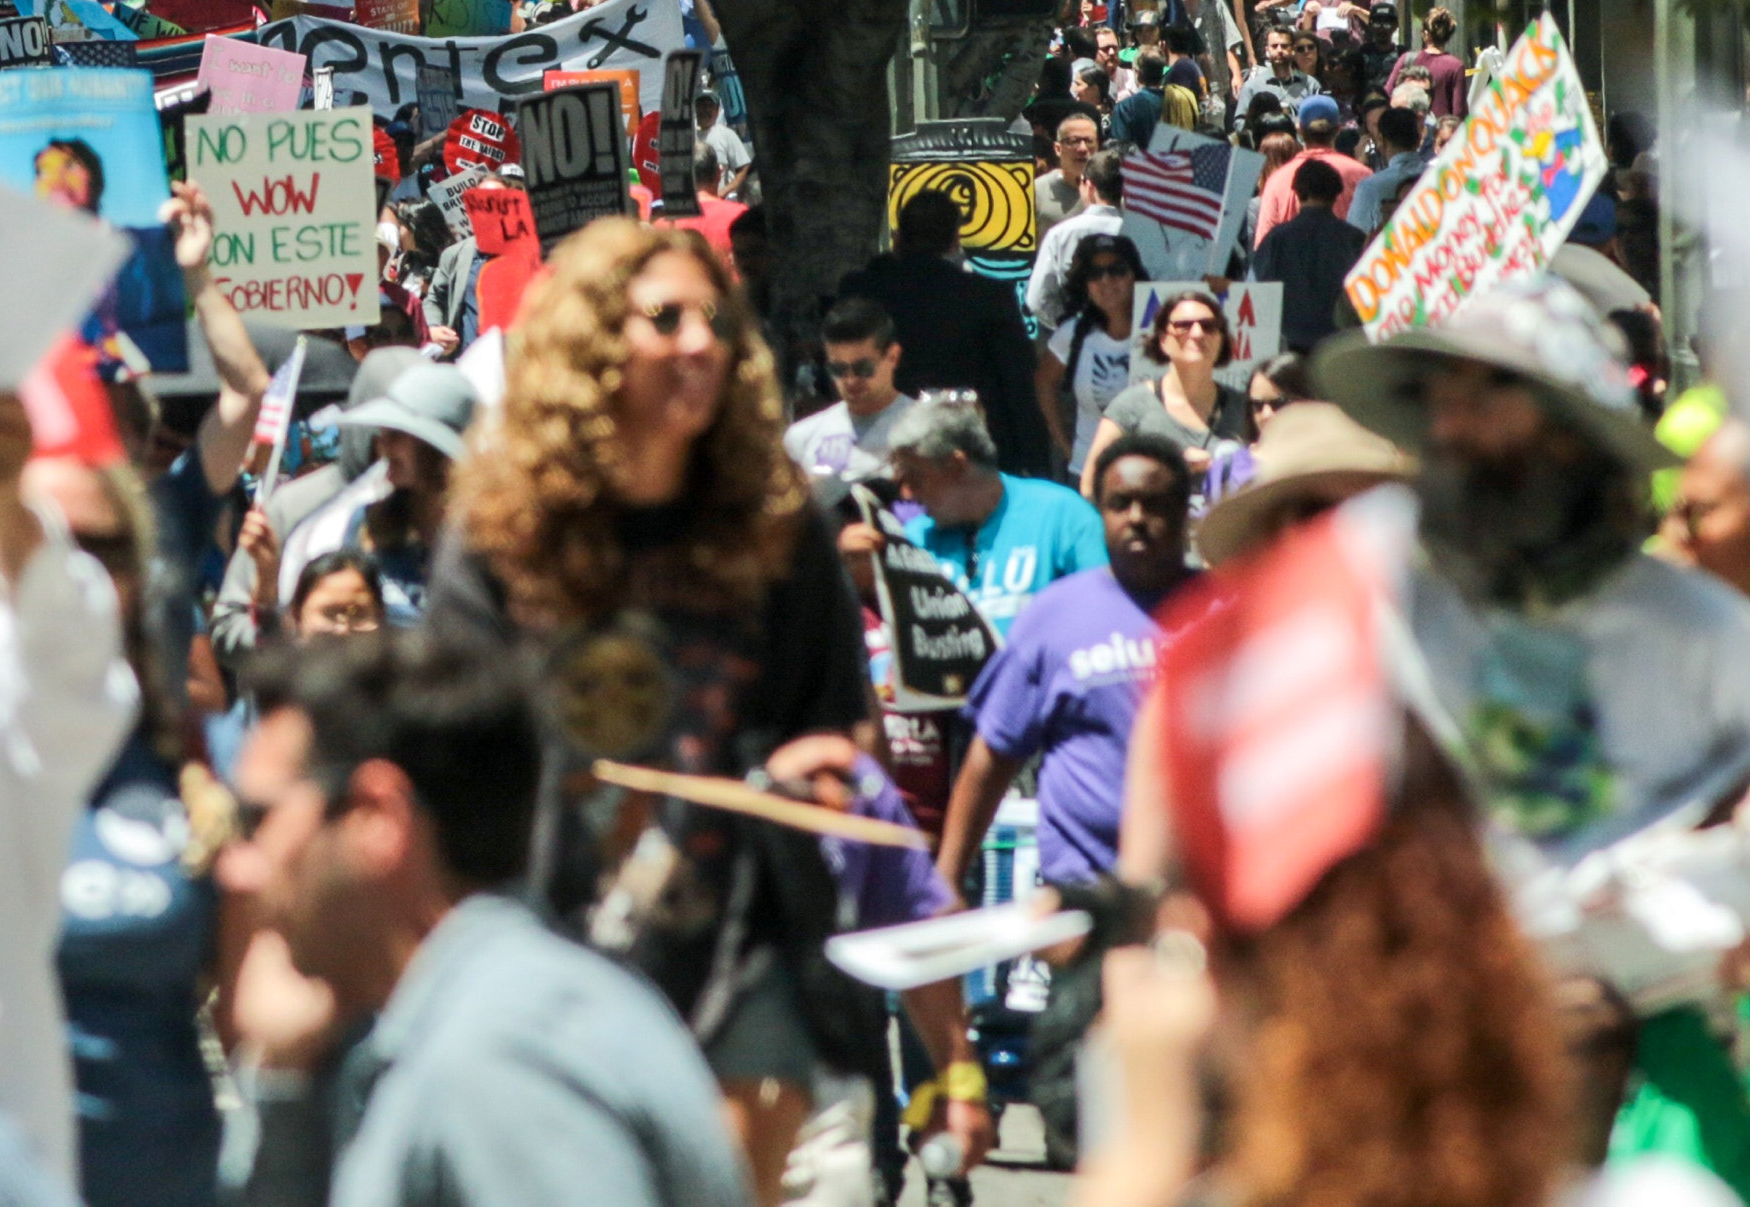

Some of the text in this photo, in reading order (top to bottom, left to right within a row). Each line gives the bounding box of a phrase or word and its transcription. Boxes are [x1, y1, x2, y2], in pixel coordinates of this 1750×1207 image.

[0, 23, 50, 61] NO!
[229, 58, 271, 78] want
[198, 118, 363, 166] NO PUES
[472, 114, 504, 140] STOP
[521, 93, 617, 188] NO!
[231, 172, 320, 216] WOW
[446, 176, 477, 198] BUILD
[1346, 186, 1445, 323] DONALD
[1468, 26, 1559, 158] QUACK
[208, 223, 362, 267] ON ESTE
[500, 219, 529, 243] LA
[910, 586, 971, 621] Union
[912, 623, 987, 662] Busting
[1068, 632, 1157, 680] seiu
